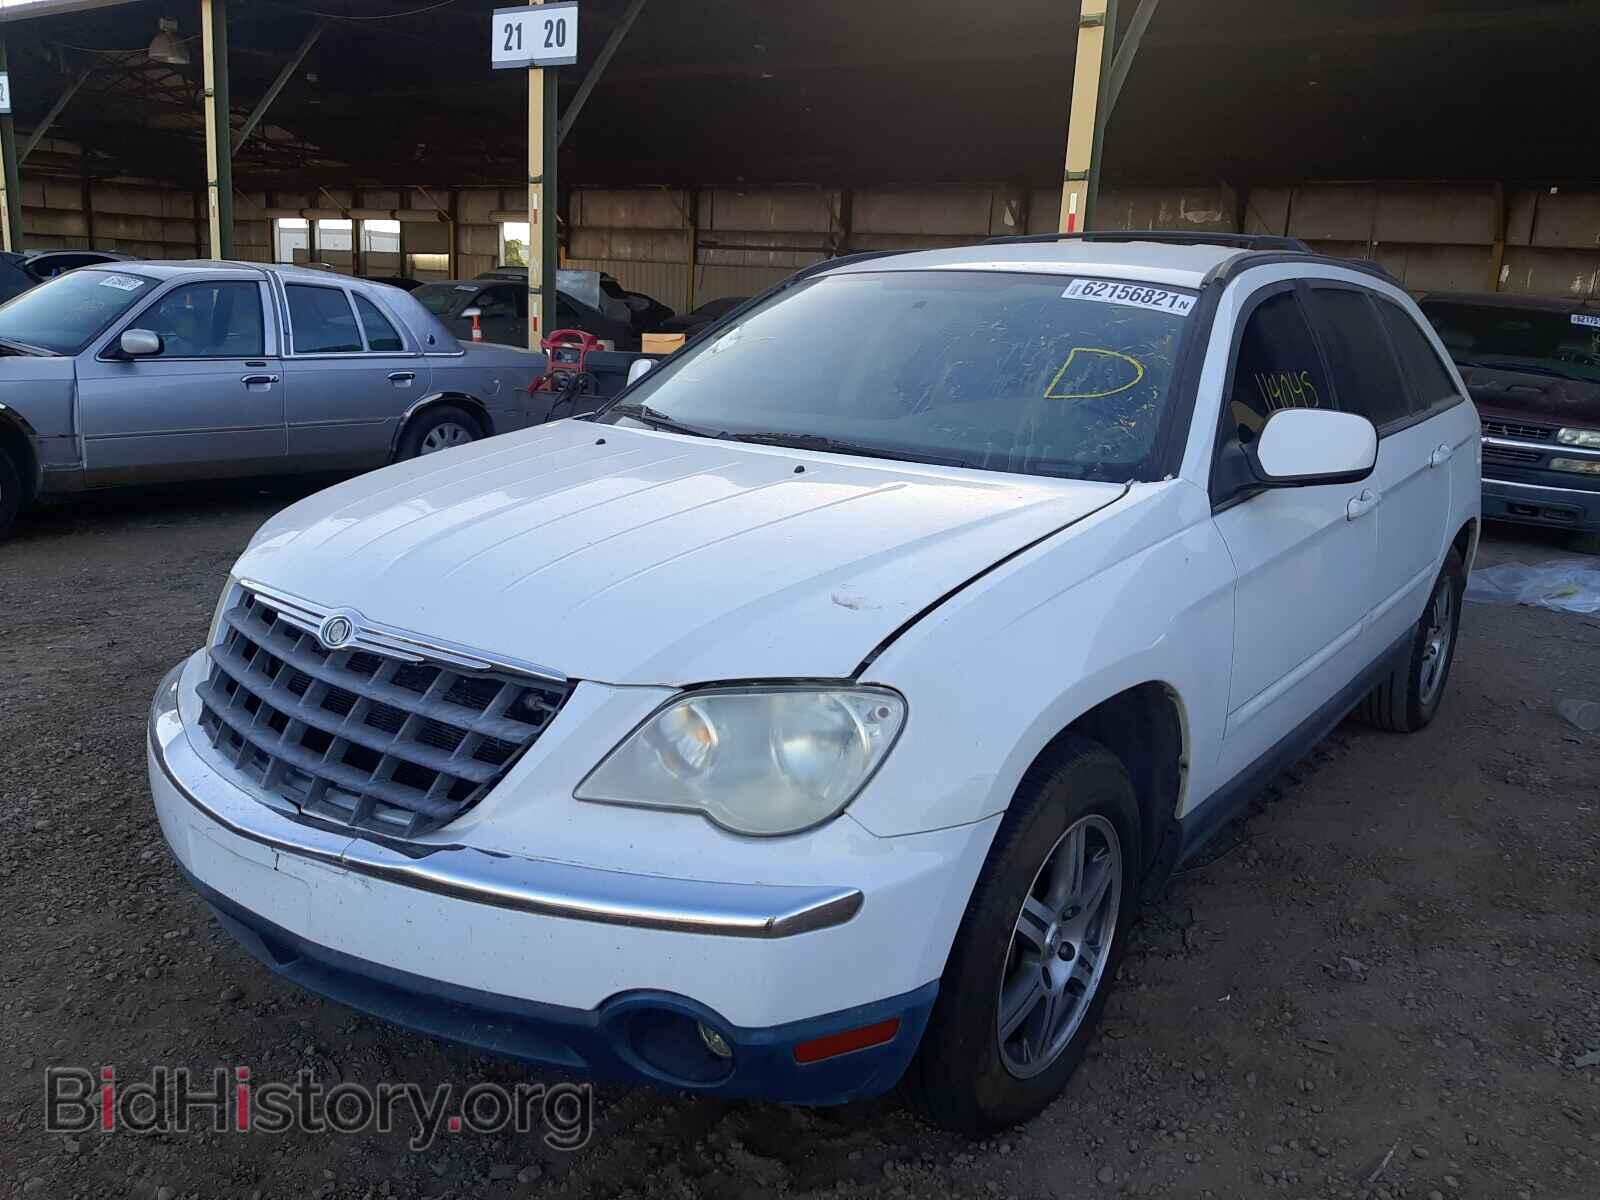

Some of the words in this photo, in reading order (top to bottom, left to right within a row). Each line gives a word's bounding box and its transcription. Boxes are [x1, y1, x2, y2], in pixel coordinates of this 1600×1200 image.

[504, 22, 523, 51] 21
[544, 18, 566, 48] 20
[1081, 282, 1178, 308] 62156821
[1044, 347, 1144, 399] D
